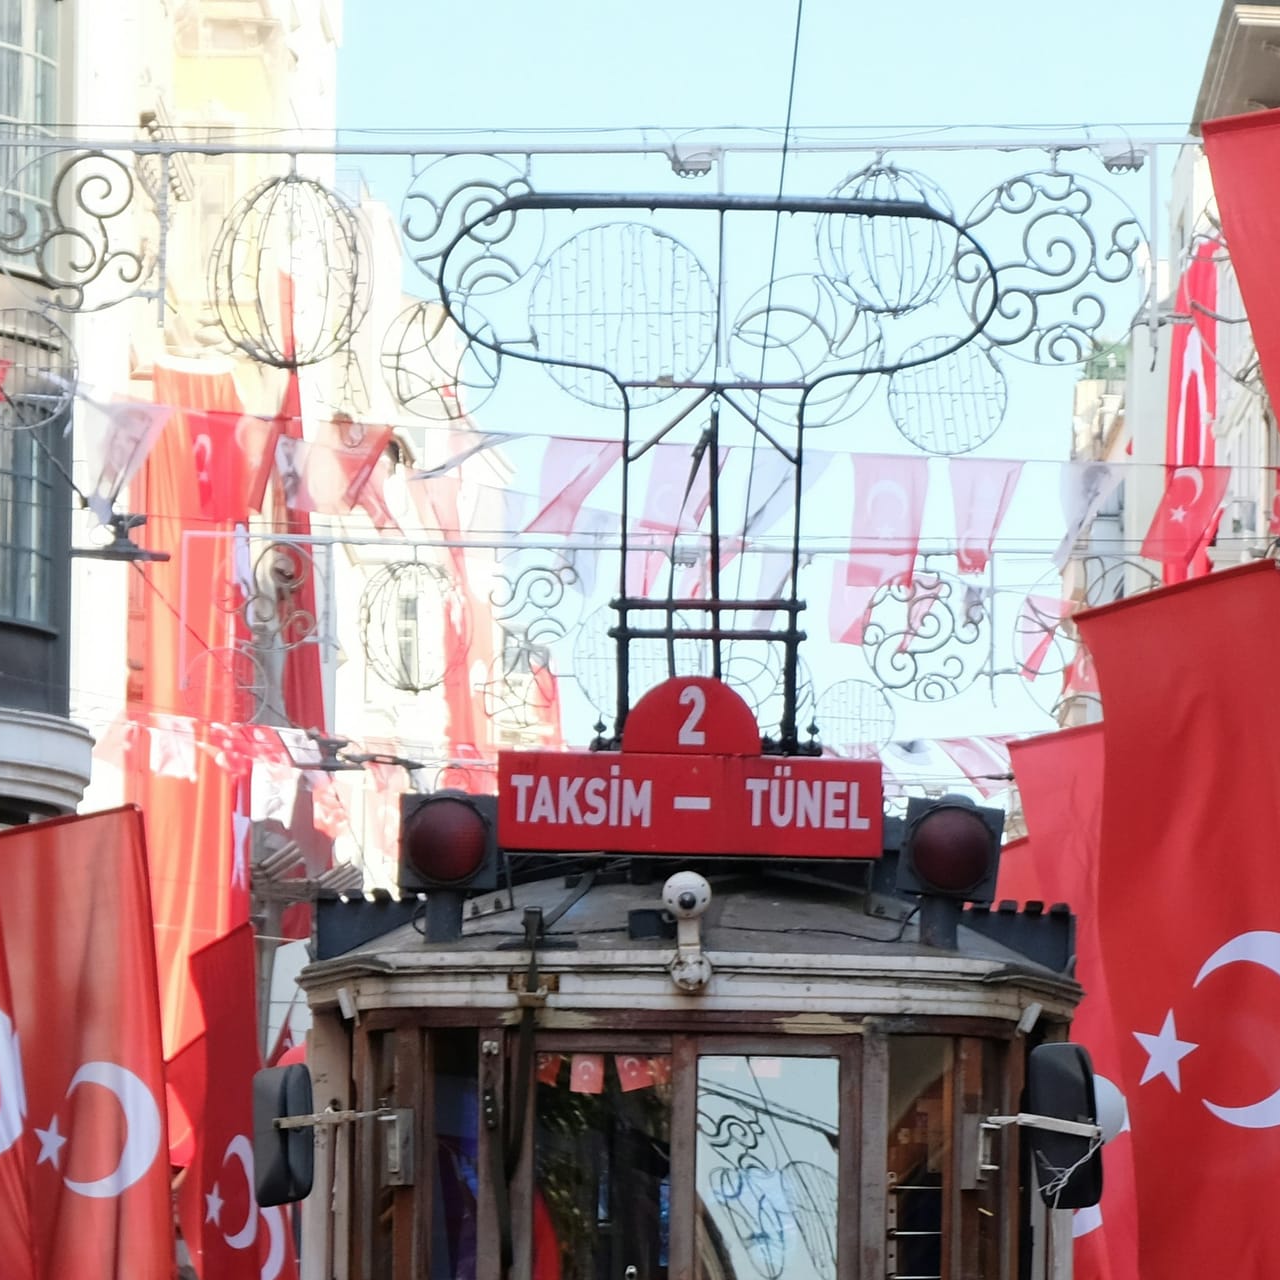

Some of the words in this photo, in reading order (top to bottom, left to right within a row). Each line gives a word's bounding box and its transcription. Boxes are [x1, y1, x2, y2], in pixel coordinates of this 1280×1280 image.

[678, 685, 707, 746] 2
[510, 765, 653, 828] TAKSİM
[745, 765, 871, 831] TÜNEL
